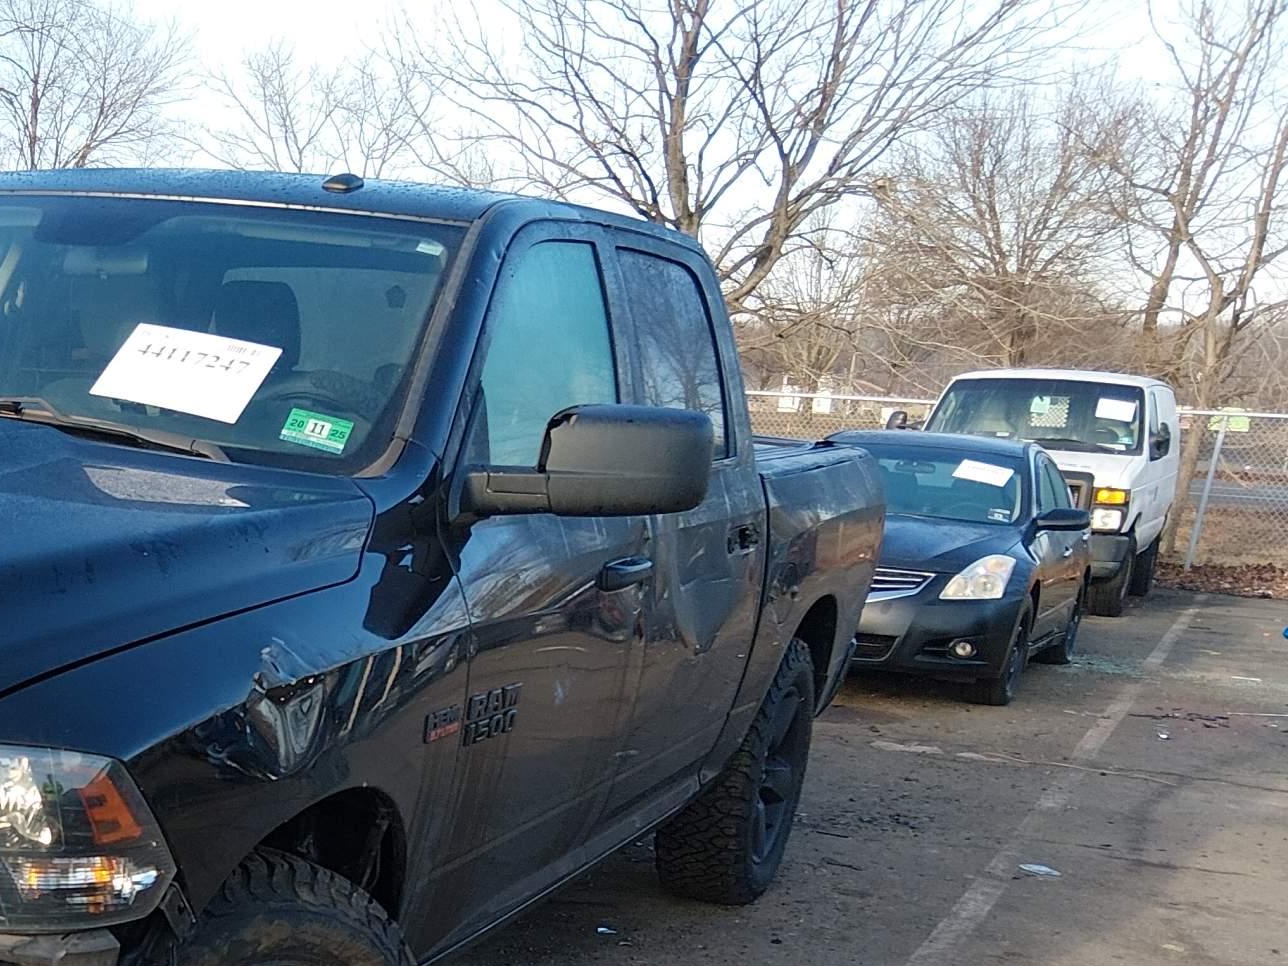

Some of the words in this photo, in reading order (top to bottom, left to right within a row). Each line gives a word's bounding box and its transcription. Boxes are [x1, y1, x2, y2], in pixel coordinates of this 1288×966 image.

[137, 343, 251, 375] 44117247
[290, 419, 305, 429] 20
[310, 422, 326, 436] 11
[330, 429, 347, 440] 25
[467, 682, 524, 721] RAM
[463, 708, 518, 747] 1500
